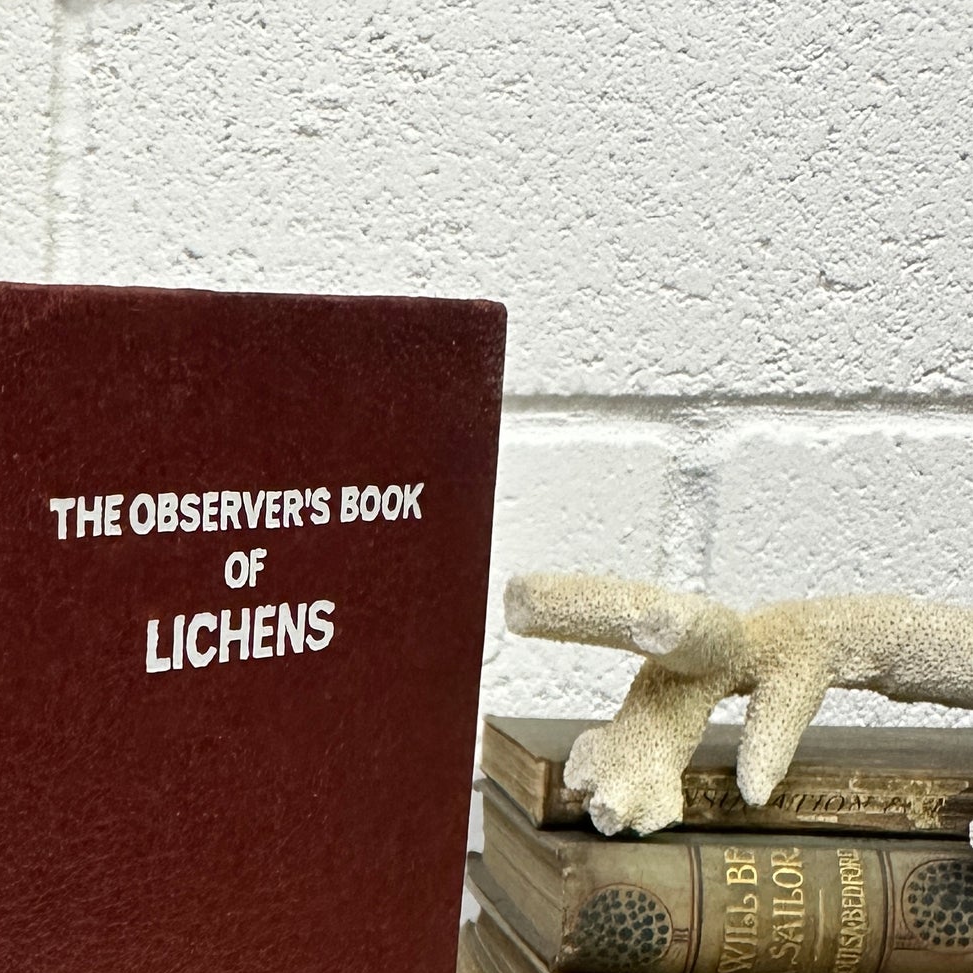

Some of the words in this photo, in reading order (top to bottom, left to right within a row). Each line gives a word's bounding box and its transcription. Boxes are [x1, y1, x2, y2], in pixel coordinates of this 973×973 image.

[49, 493, 125, 540] THE
[129, 487, 331, 535] OBSERVER'S
[340, 482, 425, 523] BOOK
[224, 547, 268, 589] OF
[146, 600, 335, 673] LICHENS
[724, 846, 758, 886] BE
[769, 847, 804, 968] SAILOR
